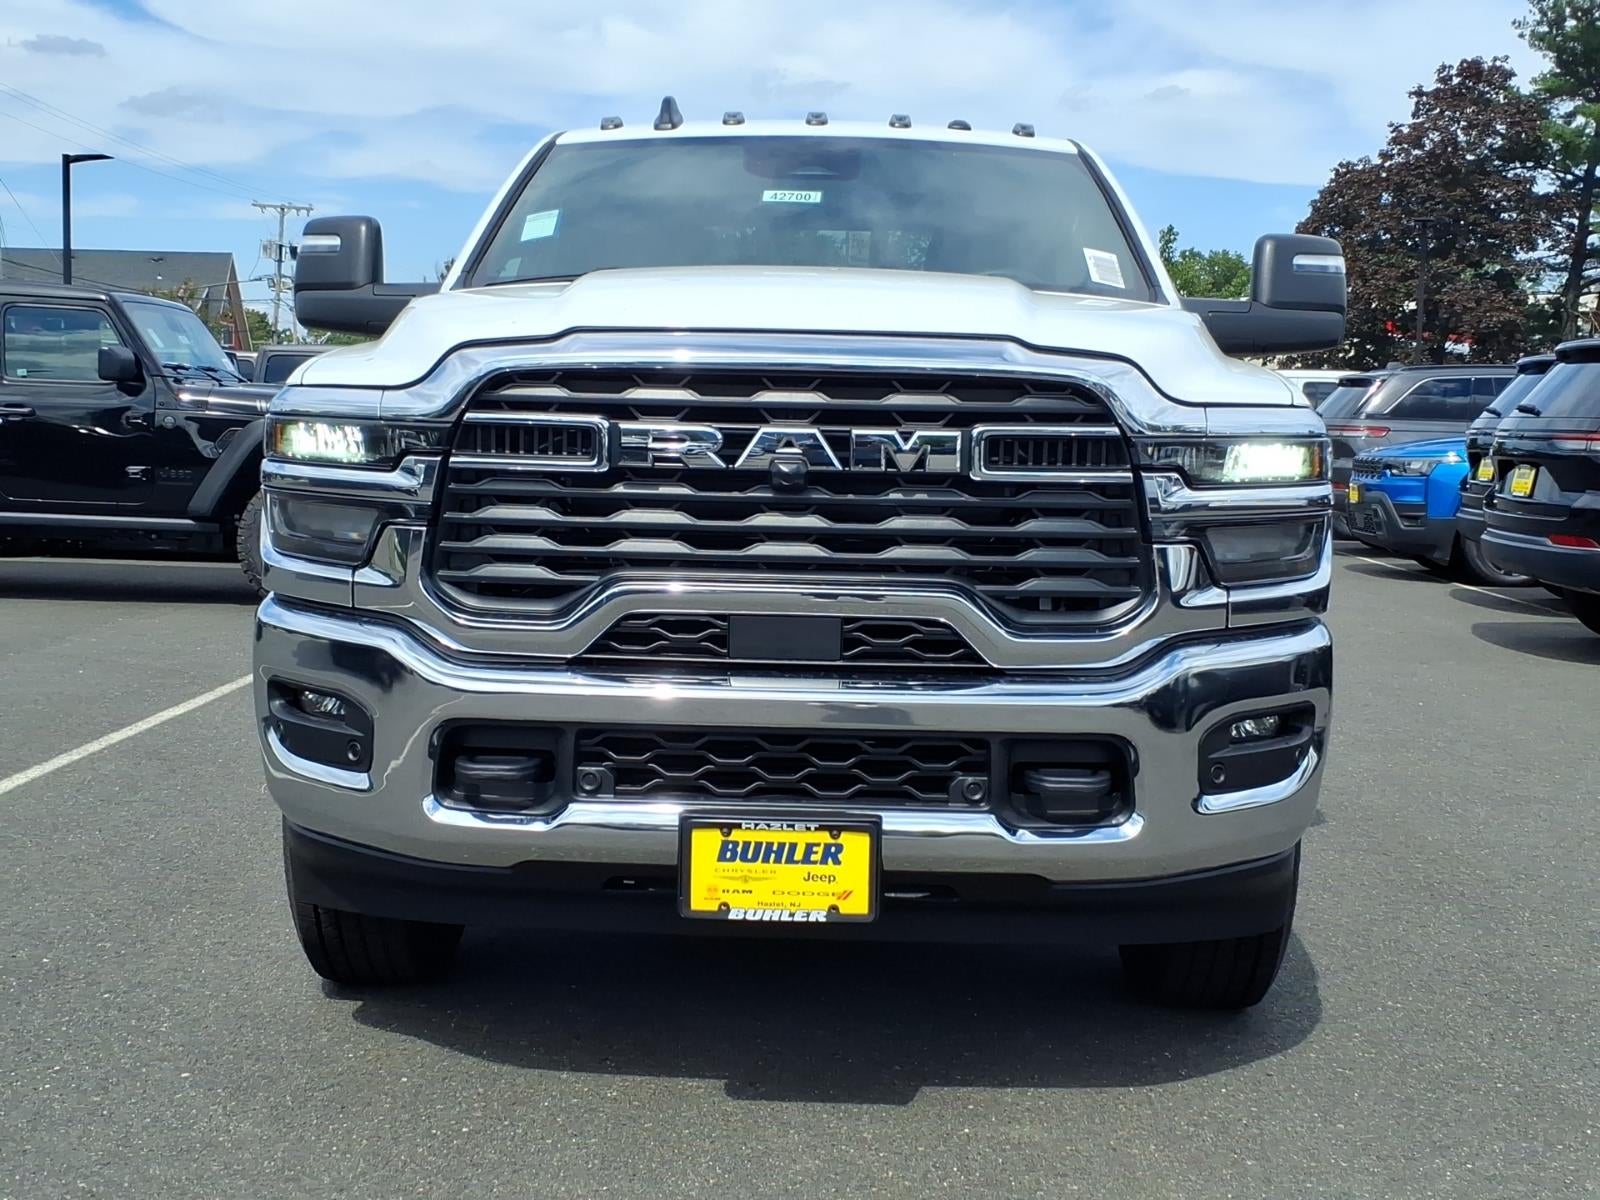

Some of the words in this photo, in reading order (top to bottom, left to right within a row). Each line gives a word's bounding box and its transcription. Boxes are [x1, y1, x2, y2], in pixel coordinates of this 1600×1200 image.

[769, 192, 812, 201] 42700
[619, 424, 963, 473] RAM
[741, 821, 820, 832] HAZLET
[716, 839, 845, 866] BUHLER
[803, 871, 836, 884] Jeep
[728, 908, 828, 922] BUHLER
